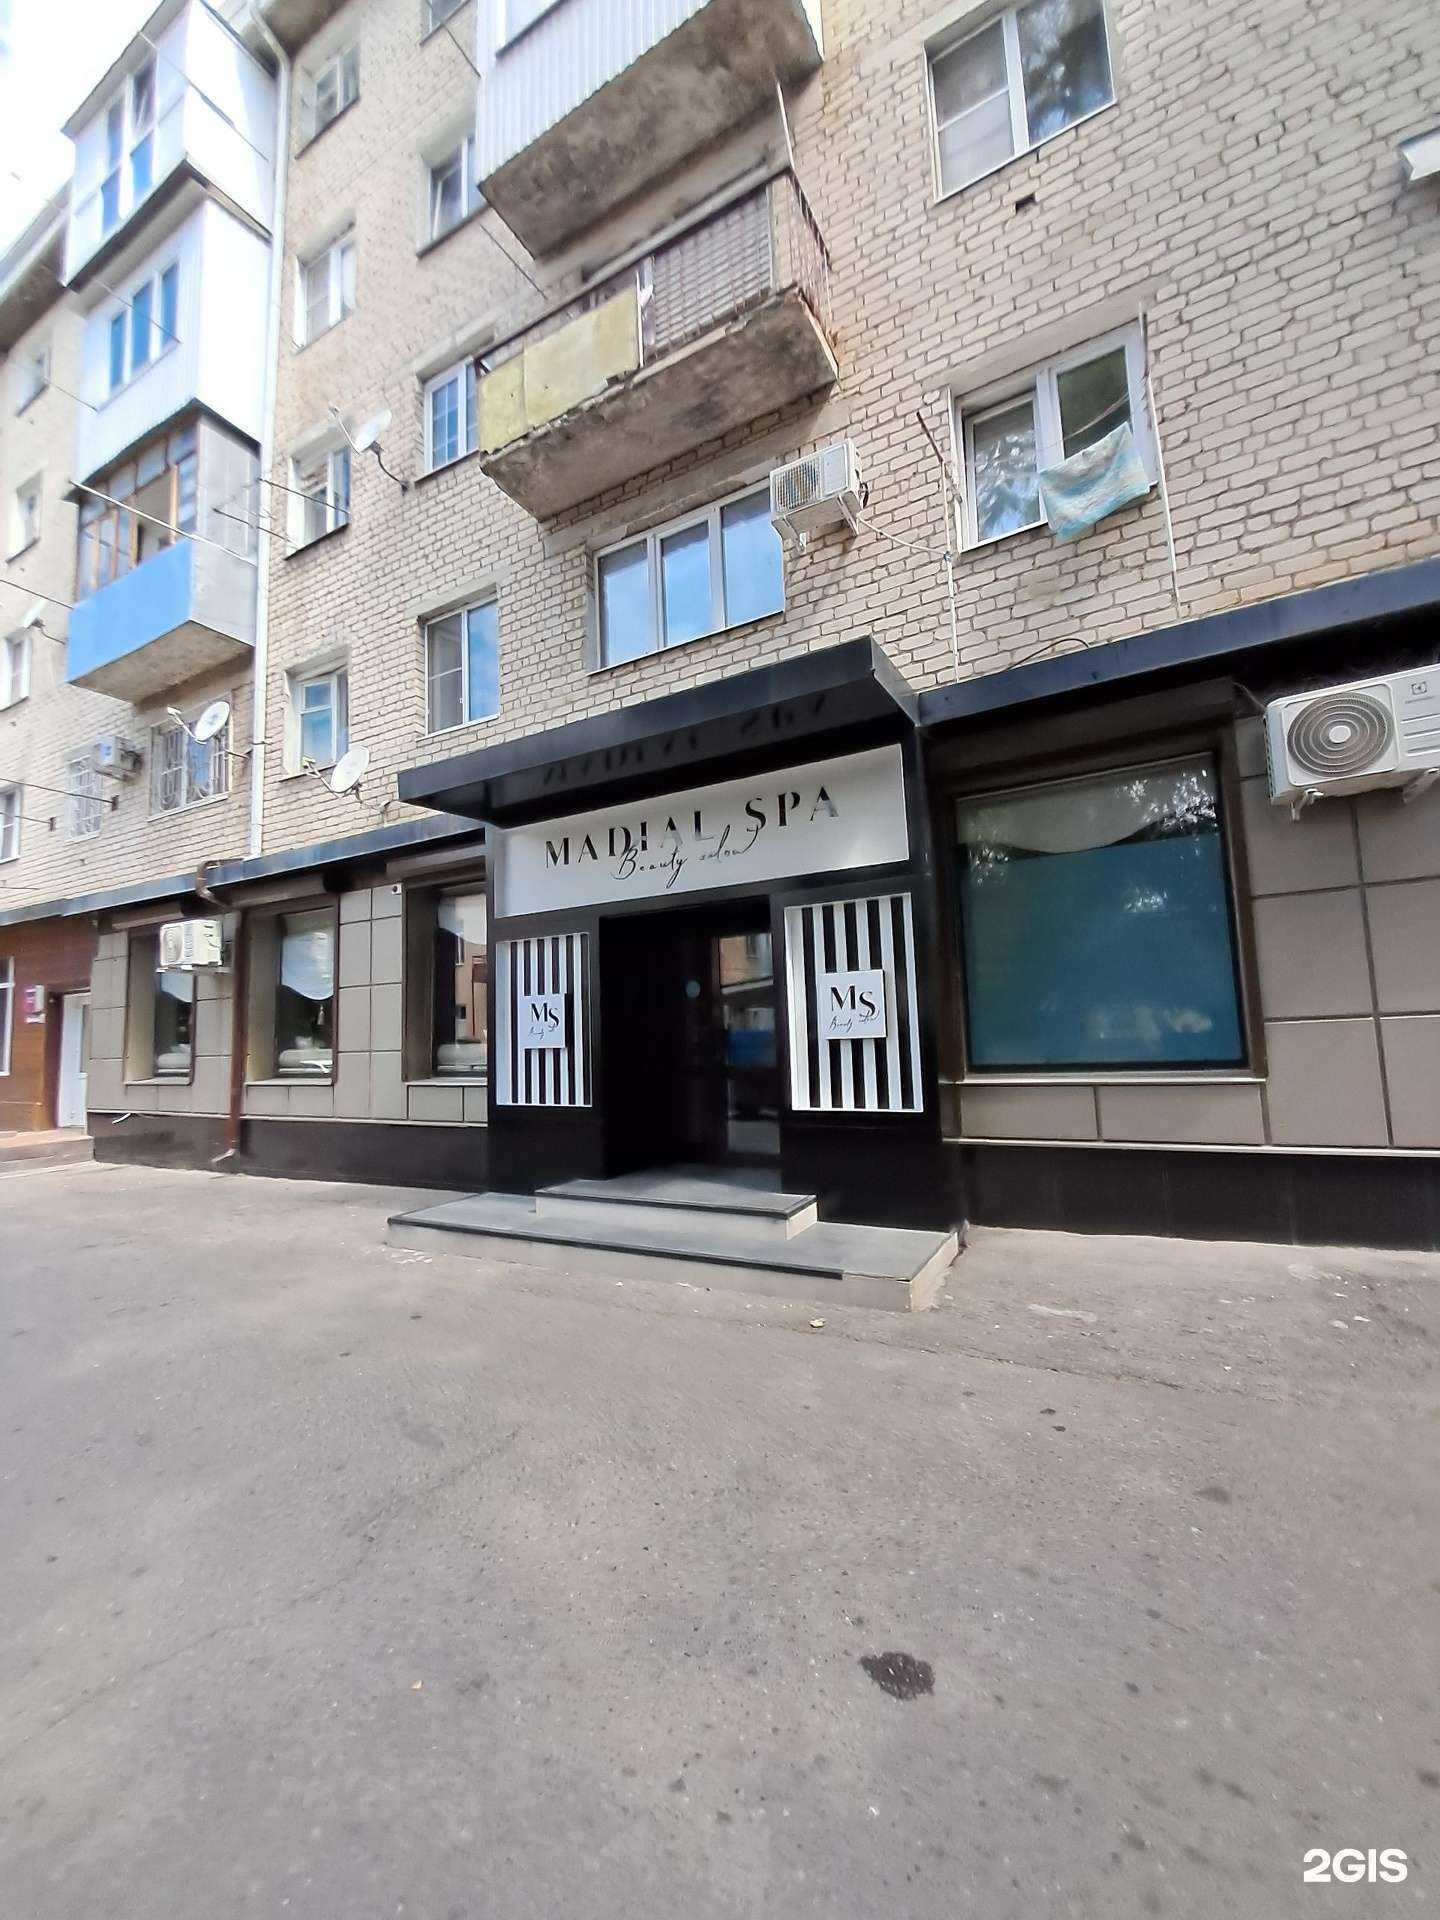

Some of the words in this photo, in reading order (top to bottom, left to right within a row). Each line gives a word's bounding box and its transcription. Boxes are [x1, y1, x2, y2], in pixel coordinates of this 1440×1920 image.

[545, 810, 714, 870] MADIAL
[745, 786, 839, 831] SPA
[609, 843, 688, 889] Beauty
[531, 1002, 560, 1027] MS
[831, 985, 876, 1017] MS
